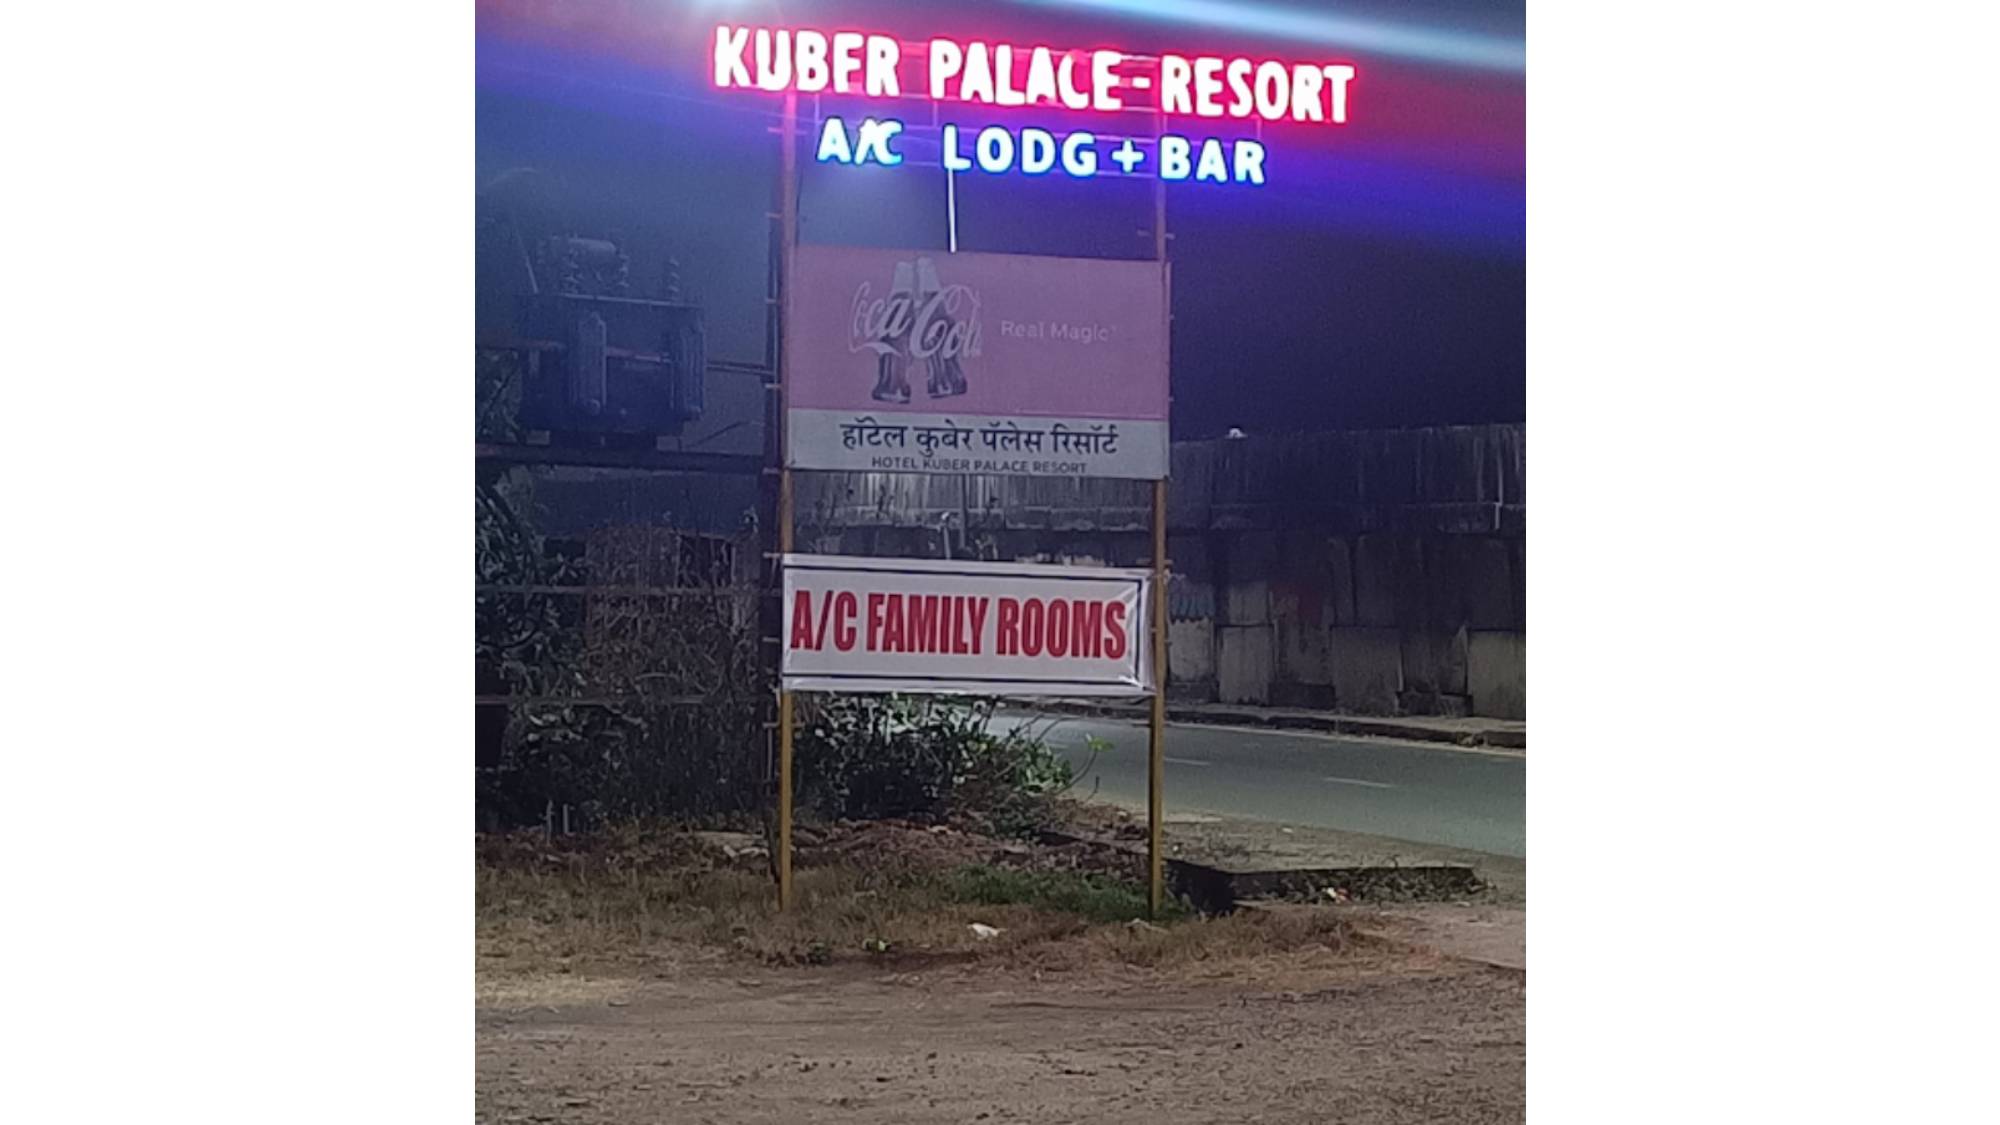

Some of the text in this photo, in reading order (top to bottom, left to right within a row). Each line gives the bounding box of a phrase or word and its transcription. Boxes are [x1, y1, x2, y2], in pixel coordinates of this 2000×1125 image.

[943, 124, 1098, 177] LODG
[1159, 135, 1266, 185] BAR
[1000, 320, 1109, 345] Real Magic
[839, 415, 1119, 458] हॉटेल कुबेर पॅलेस रिसॉर्ट
[871, 456, 1087, 474] HOTEL KUBER PALACE RESORT
[790, 589, 1126, 661] A/C FAMILY ROOMS
